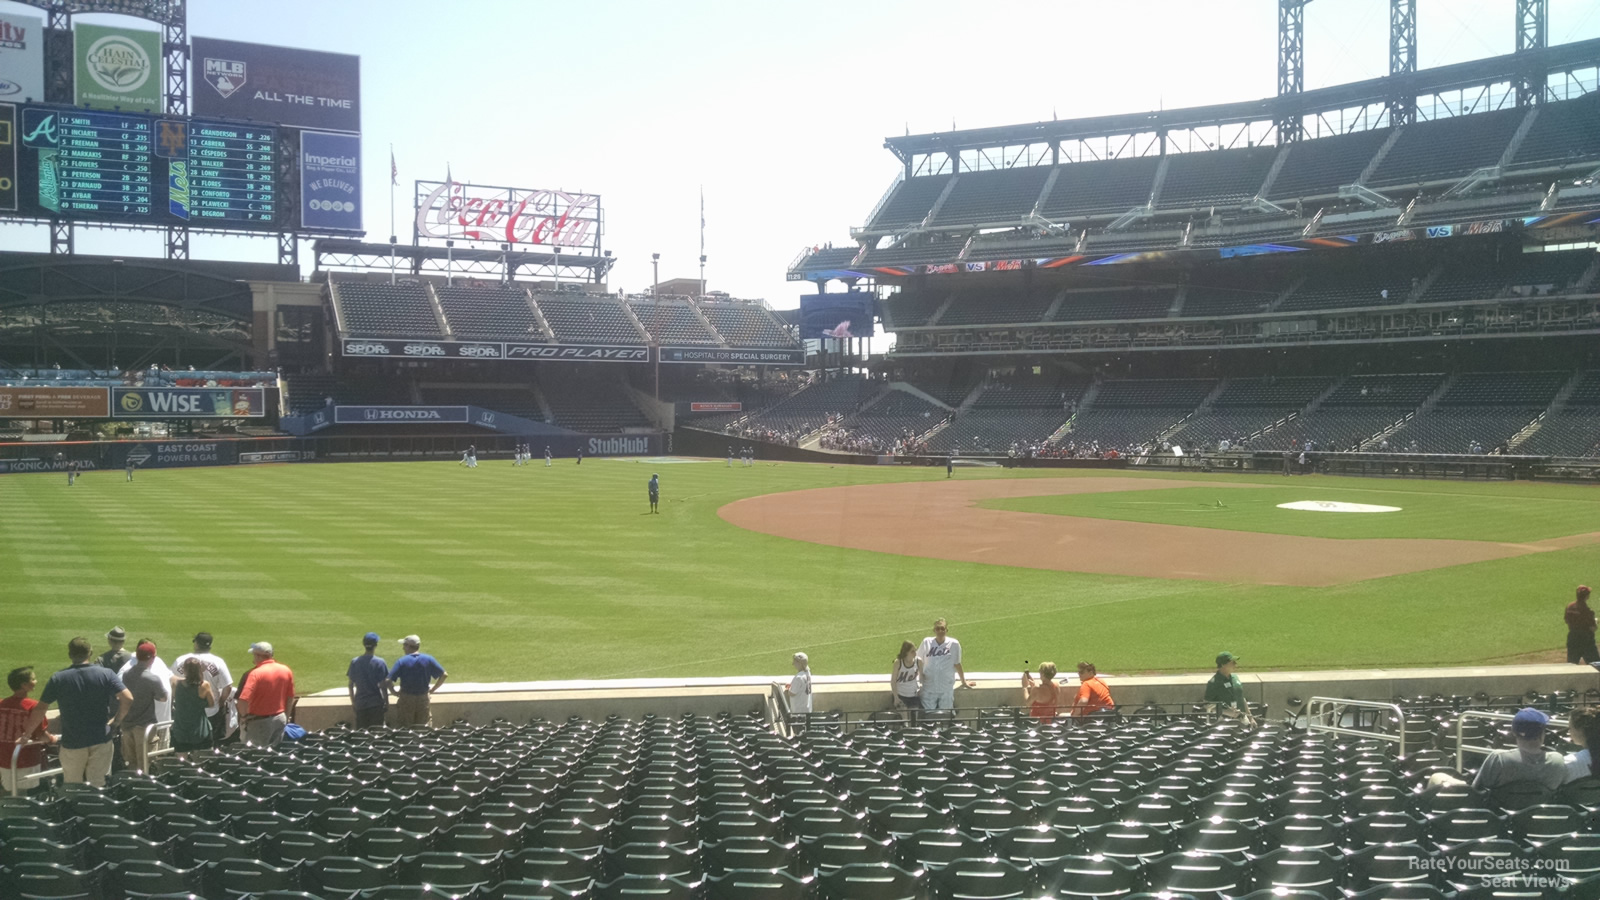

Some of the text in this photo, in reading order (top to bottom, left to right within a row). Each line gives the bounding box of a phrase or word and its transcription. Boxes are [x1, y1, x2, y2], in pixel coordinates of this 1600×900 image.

[103, 48, 134, 59] HAIN
[88, 53, 148, 69] CELESTIAL
[207, 60, 244, 74] MLB
[254, 90, 351, 108] ALL THE TIME
[305, 152, 356, 166] Imperial
[309, 178, 354, 194] WE DELIVER
[417, 182, 599, 246] Coca-Cola
[1428, 226, 1450, 238] VS
[508, 347, 646, 359] PRO PLAYER
[684, 351, 716, 359] HOSPITAL
[760, 353, 791, 361] SURGERY
[148, 392, 201, 412] WISE
[380, 410, 440, 419] HONDA
[158, 444, 217, 453] EAST COAST
[588, 438, 648, 454] StubHub!
[158, 453, 217, 462] POWER & GAS
[10, 460, 95, 471] KONICA MINOLTA
[926, 646, 950, 657] Mets
[896, 668, 918, 682] Met
